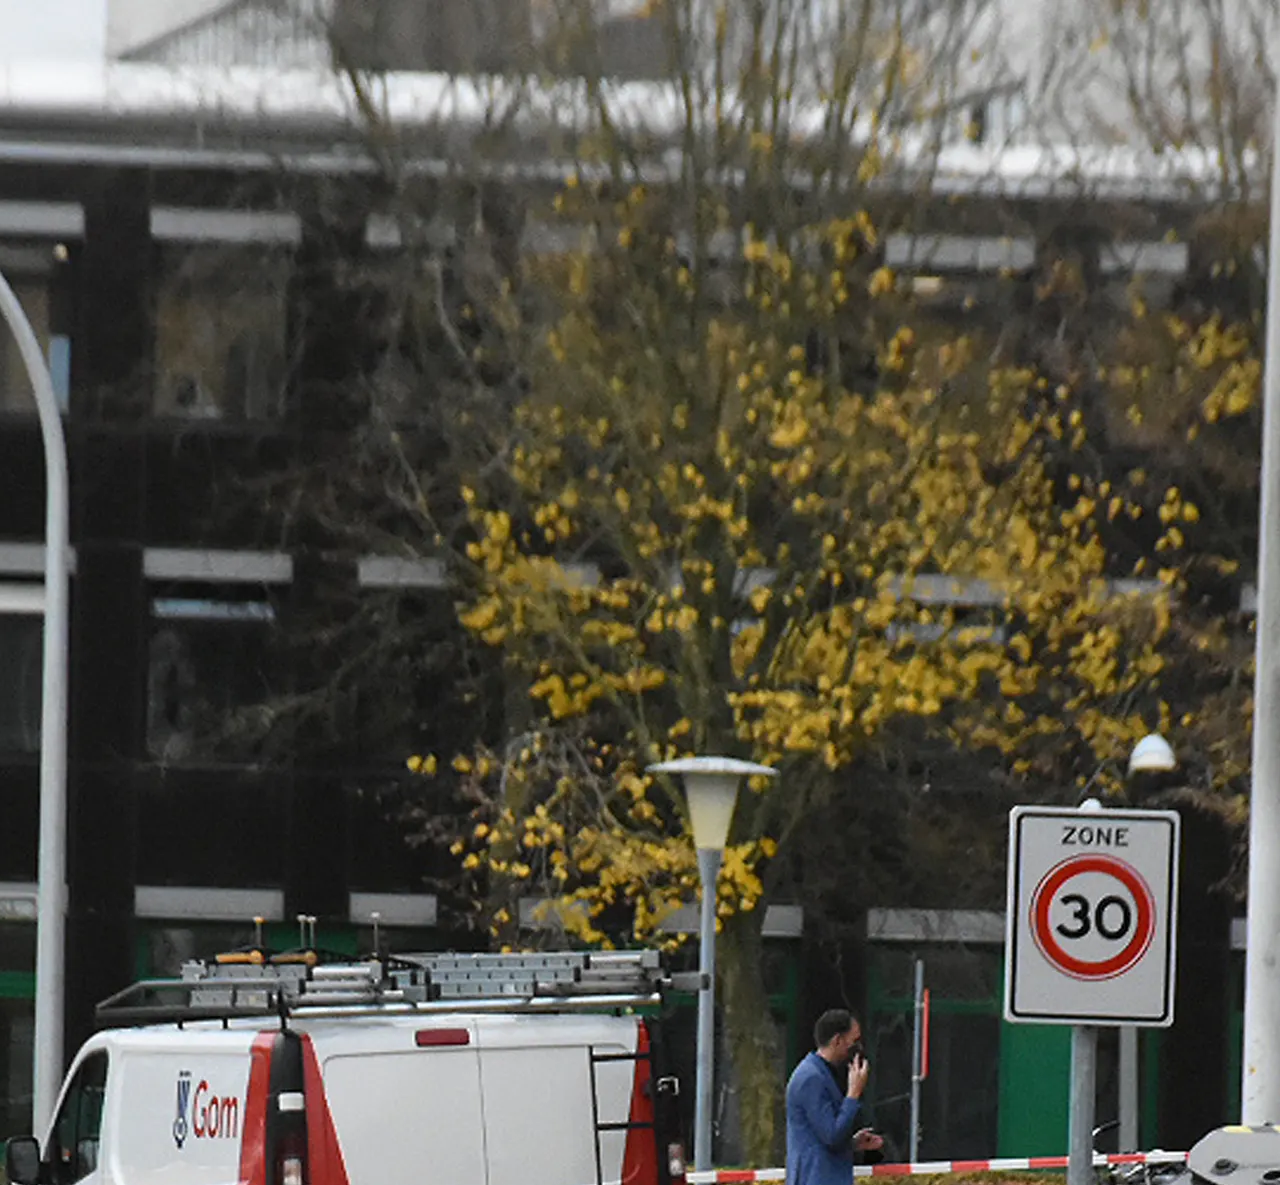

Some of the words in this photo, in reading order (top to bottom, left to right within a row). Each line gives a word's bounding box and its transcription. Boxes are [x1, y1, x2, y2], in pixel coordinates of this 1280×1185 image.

[1061, 826, 1129, 847] ZONE
[1056, 893, 1132, 940] 30
[192, 1079, 238, 1138] Gom
